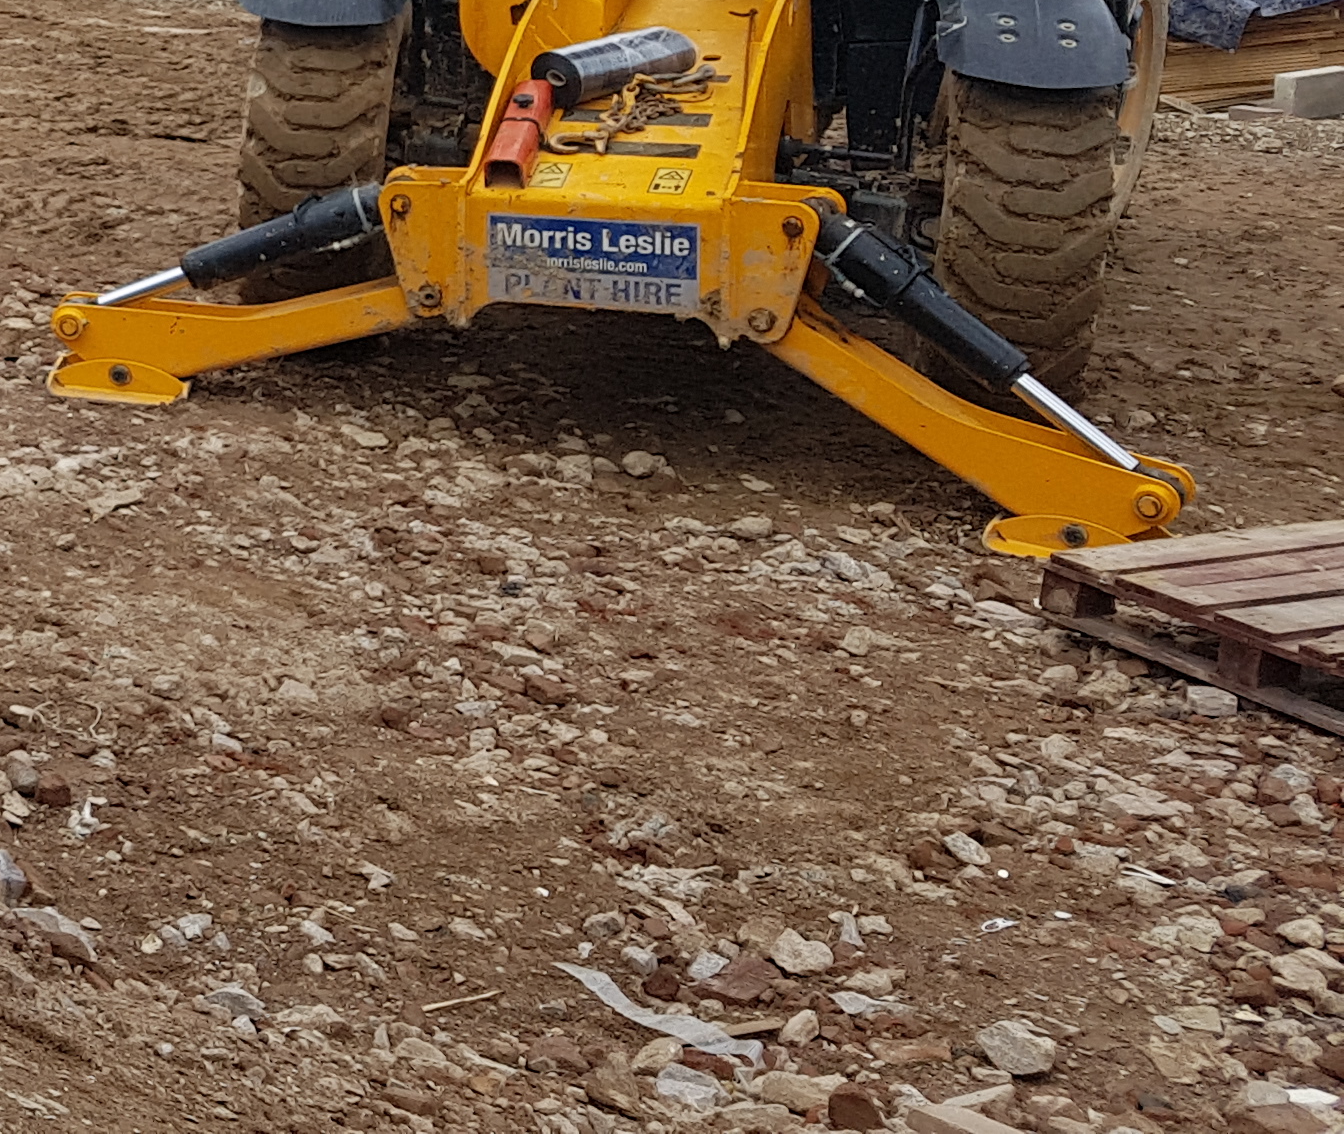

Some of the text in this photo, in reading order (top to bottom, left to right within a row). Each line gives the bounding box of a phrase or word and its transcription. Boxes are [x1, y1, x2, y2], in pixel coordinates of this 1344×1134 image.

[496, 222, 691, 257] Morris Leslie
[612, 279, 681, 306] HIRE
